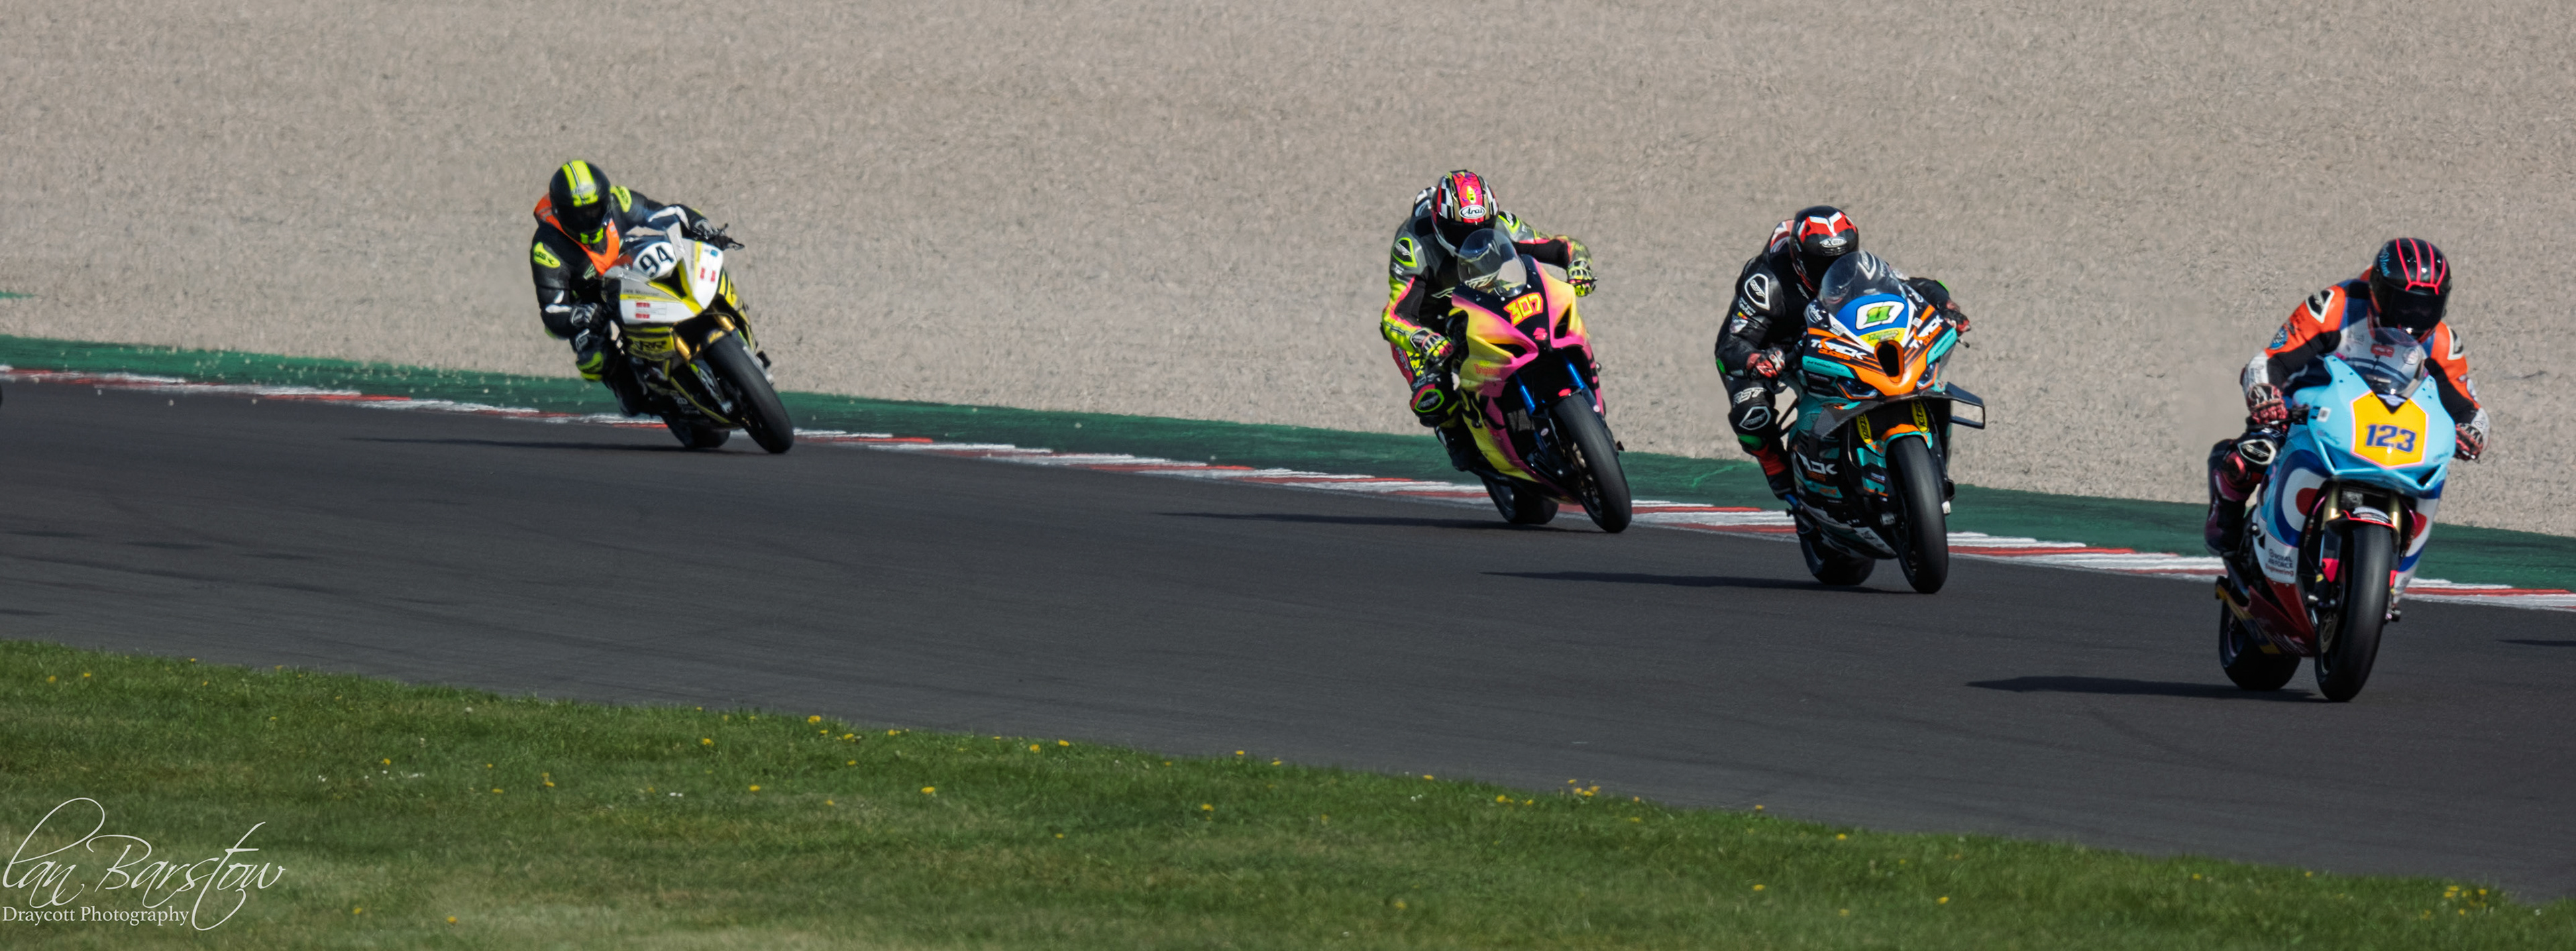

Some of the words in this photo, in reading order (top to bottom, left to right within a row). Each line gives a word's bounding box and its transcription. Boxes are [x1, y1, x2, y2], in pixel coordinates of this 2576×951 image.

[639, 245, 674, 278] 94
[1505, 293, 1542, 326] 307
[2365, 424, 2416, 453] 123
